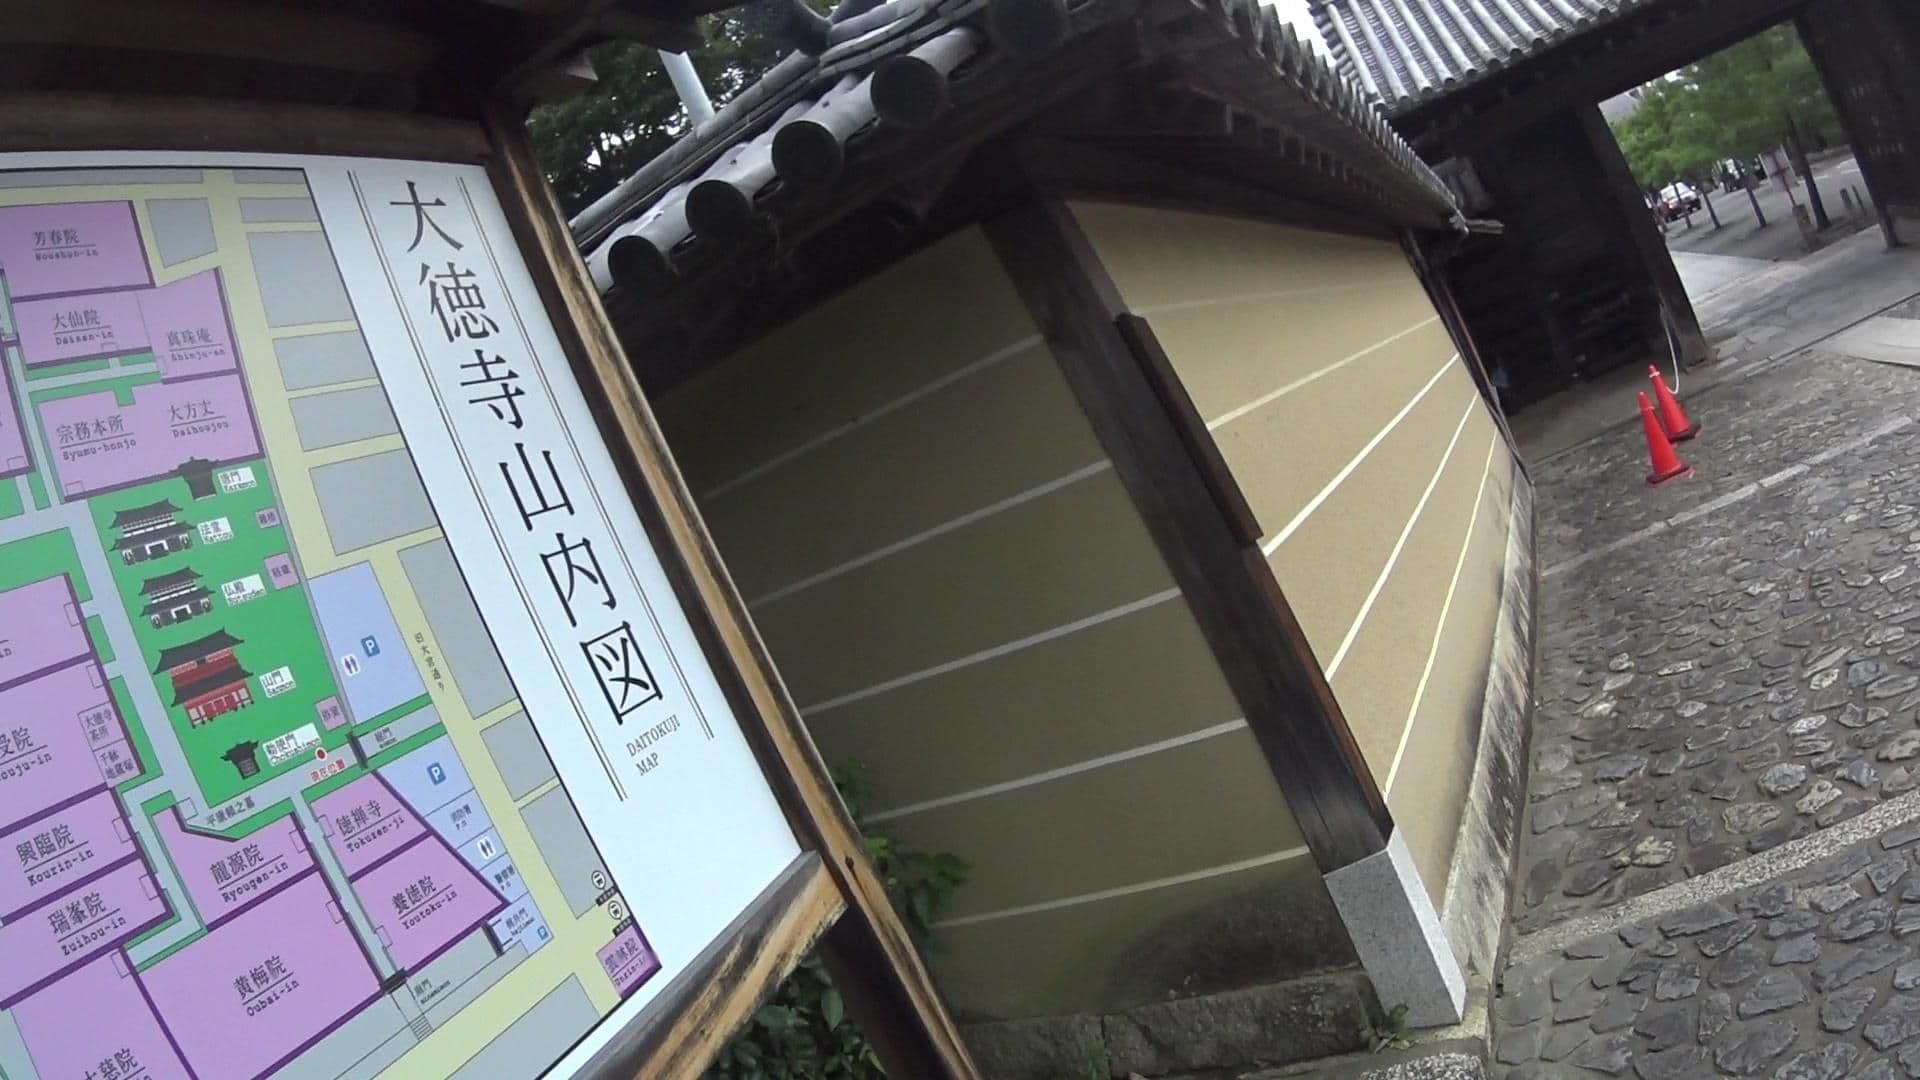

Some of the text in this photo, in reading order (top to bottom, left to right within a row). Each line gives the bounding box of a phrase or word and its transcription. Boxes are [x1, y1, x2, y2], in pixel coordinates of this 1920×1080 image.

[53, 309, 100, 329] 大仙院
[56, 331, 114, 345] Daisen-in
[168, 400, 215, 421] 大方丈
[56, 415, 124, 444] 宗務本所
[173, 421, 229, 438] Daihoujou
[63, 439, 136, 461] Syumu-honjo
[390, 180, 663, 725] 大徳寺山内図
[626, 714, 680, 757] DAITOKUJI
[0, 753, 52, 781] ouju-in
[636, 752, 659, 776] MAP
[16, 823, 74, 866] 興臨院
[27, 849, 94, 886] Kourin-in
[210, 844, 265, 884] 龍源院
[222, 861, 289, 903] Ryougen-in
[61, 916, 126, 956] Zuihou-in
[233, 955, 287, 1000] 黄梅院
[246, 979, 299, 1017] Oubai-in
